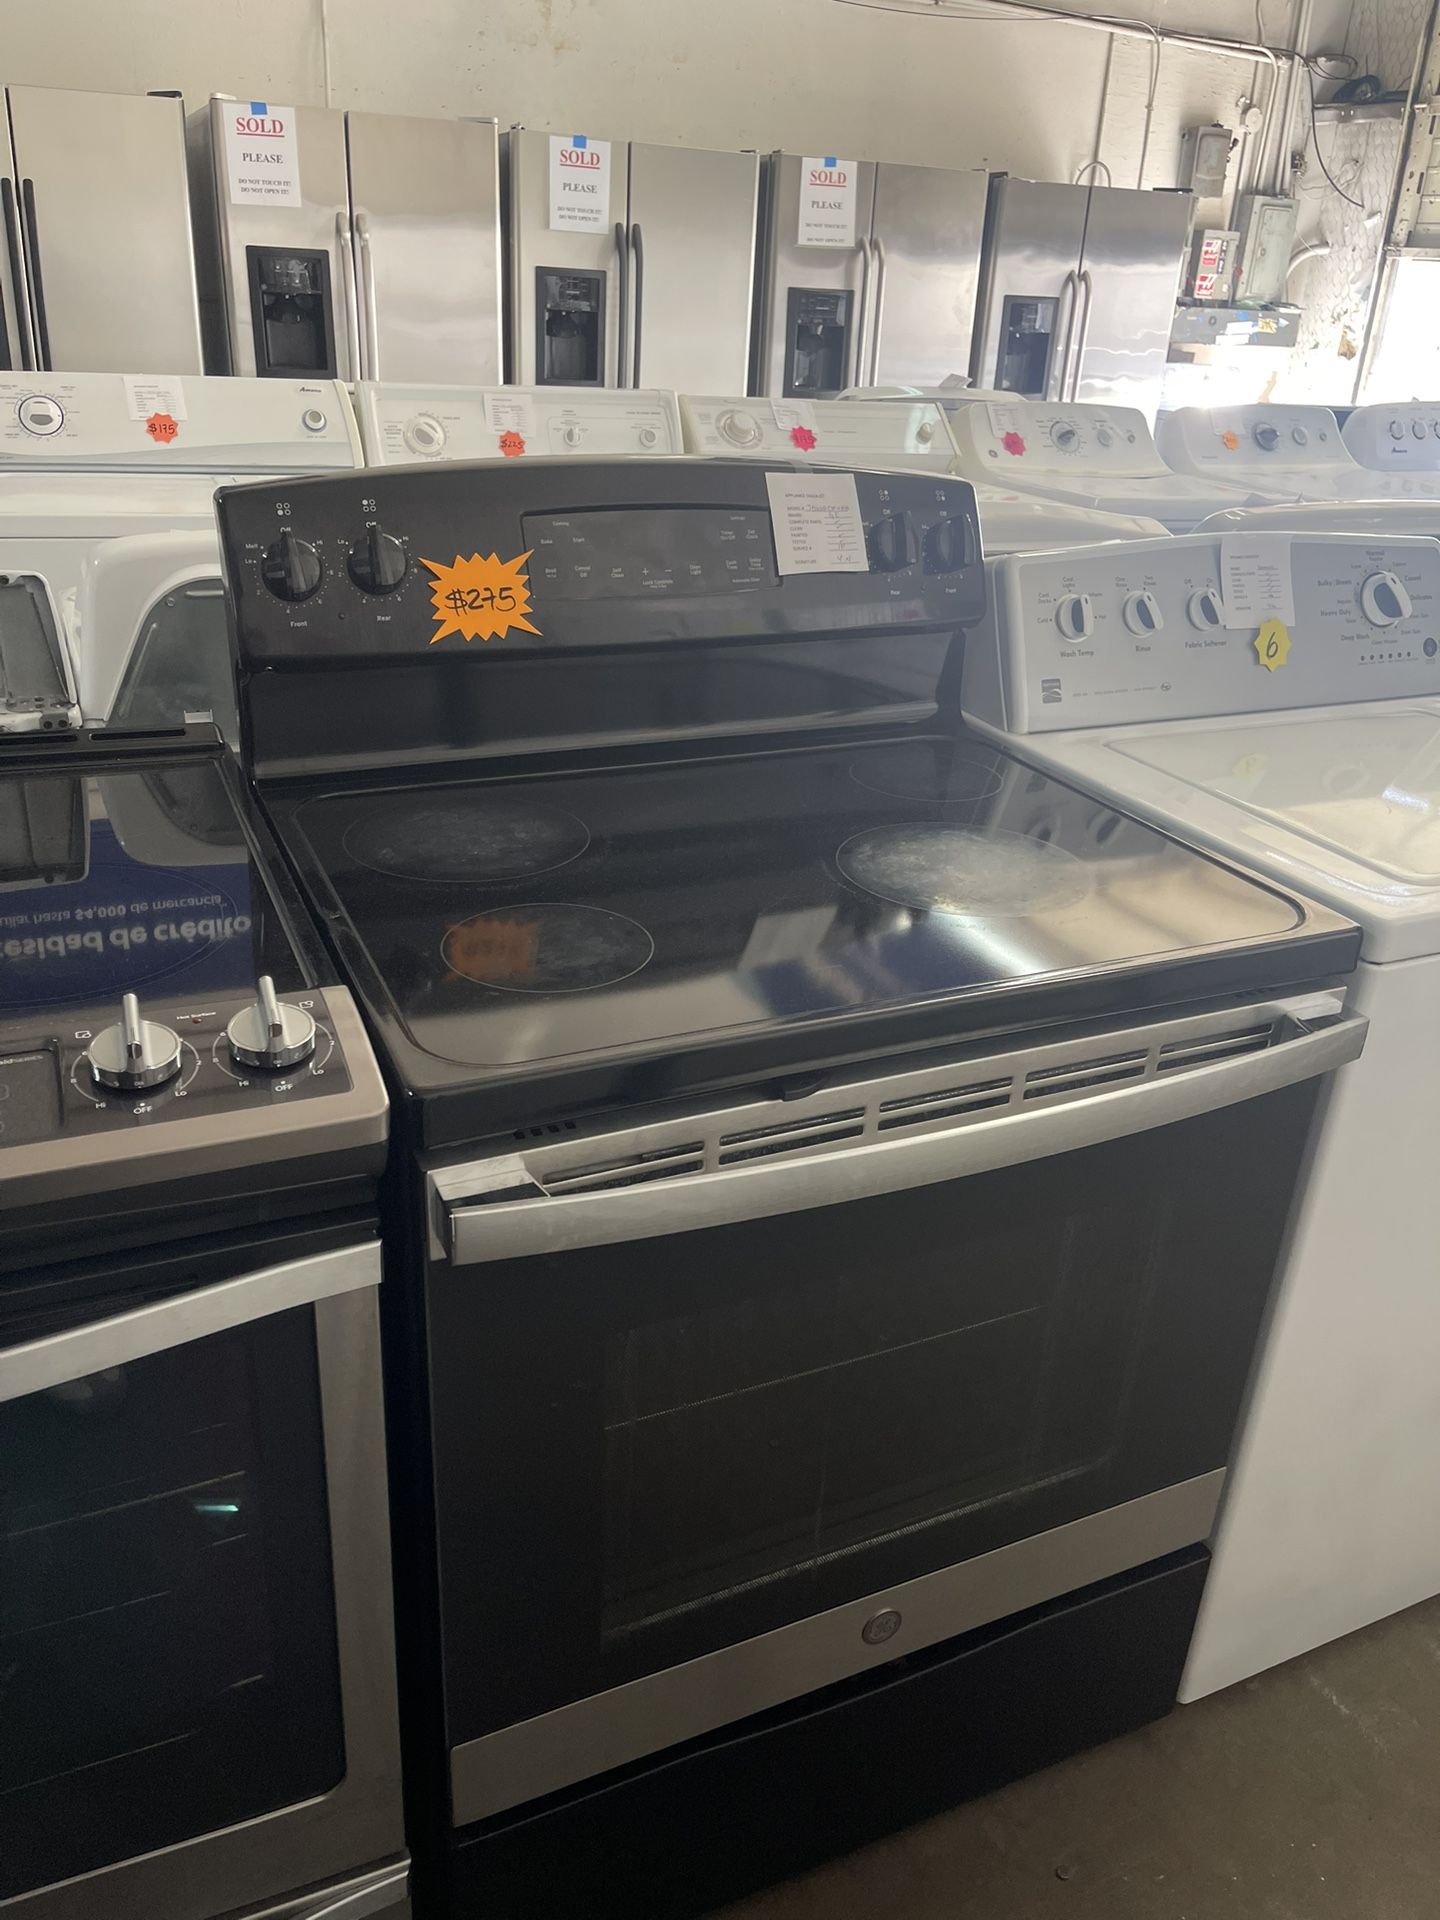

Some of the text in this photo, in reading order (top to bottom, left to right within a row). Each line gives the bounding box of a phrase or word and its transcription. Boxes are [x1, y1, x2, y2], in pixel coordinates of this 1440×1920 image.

[236, 117, 284, 134] SOLD
[242, 152, 284, 164] PLEASE
[560, 149, 600, 166] SOLD
[809, 169, 847, 185] SOLD
[261, 179, 282, 187] TOUCH
[562, 182, 598, 194] PLEASE
[811, 200, 843, 210] PLEASE
[444, 587, 517, 617] $275
[1320, 608, 1352, 617] Heavy Duty
[290, 620, 307, 628] Front
[1340, 634, 1355, 642] Deep
[1184, 639, 1227, 649] Fabric Softener
[1265, 631, 1280, 659] 6
[1060, 648, 1095, 658] Wash Temp
[274, 1083, 294, 1092] OFF
[133, 1104, 153, 1115] OFF
